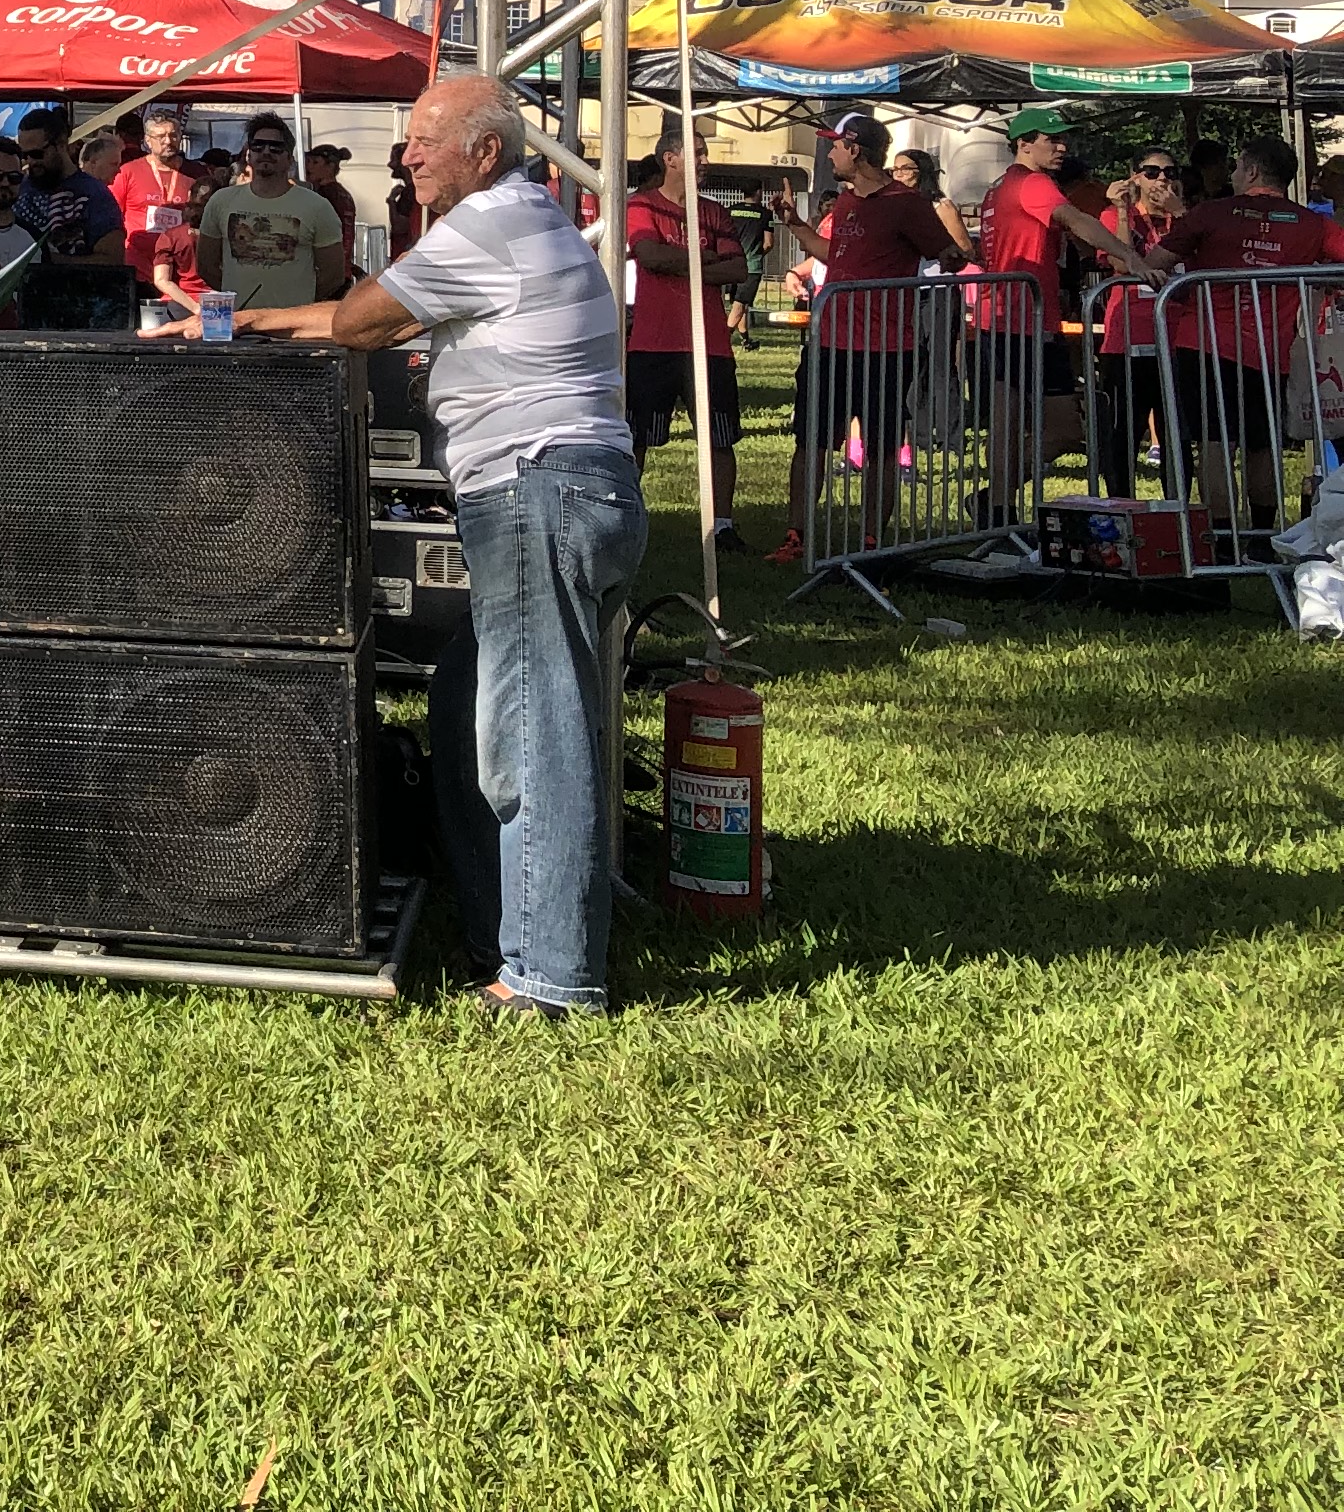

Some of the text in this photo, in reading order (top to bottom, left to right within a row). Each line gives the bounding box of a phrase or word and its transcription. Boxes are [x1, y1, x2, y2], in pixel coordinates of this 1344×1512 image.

[5, 3, 199, 41] corpore
[935, 7, 1065, 28] ESPORTIVA
[1046, 66, 1146, 84] Unimed
